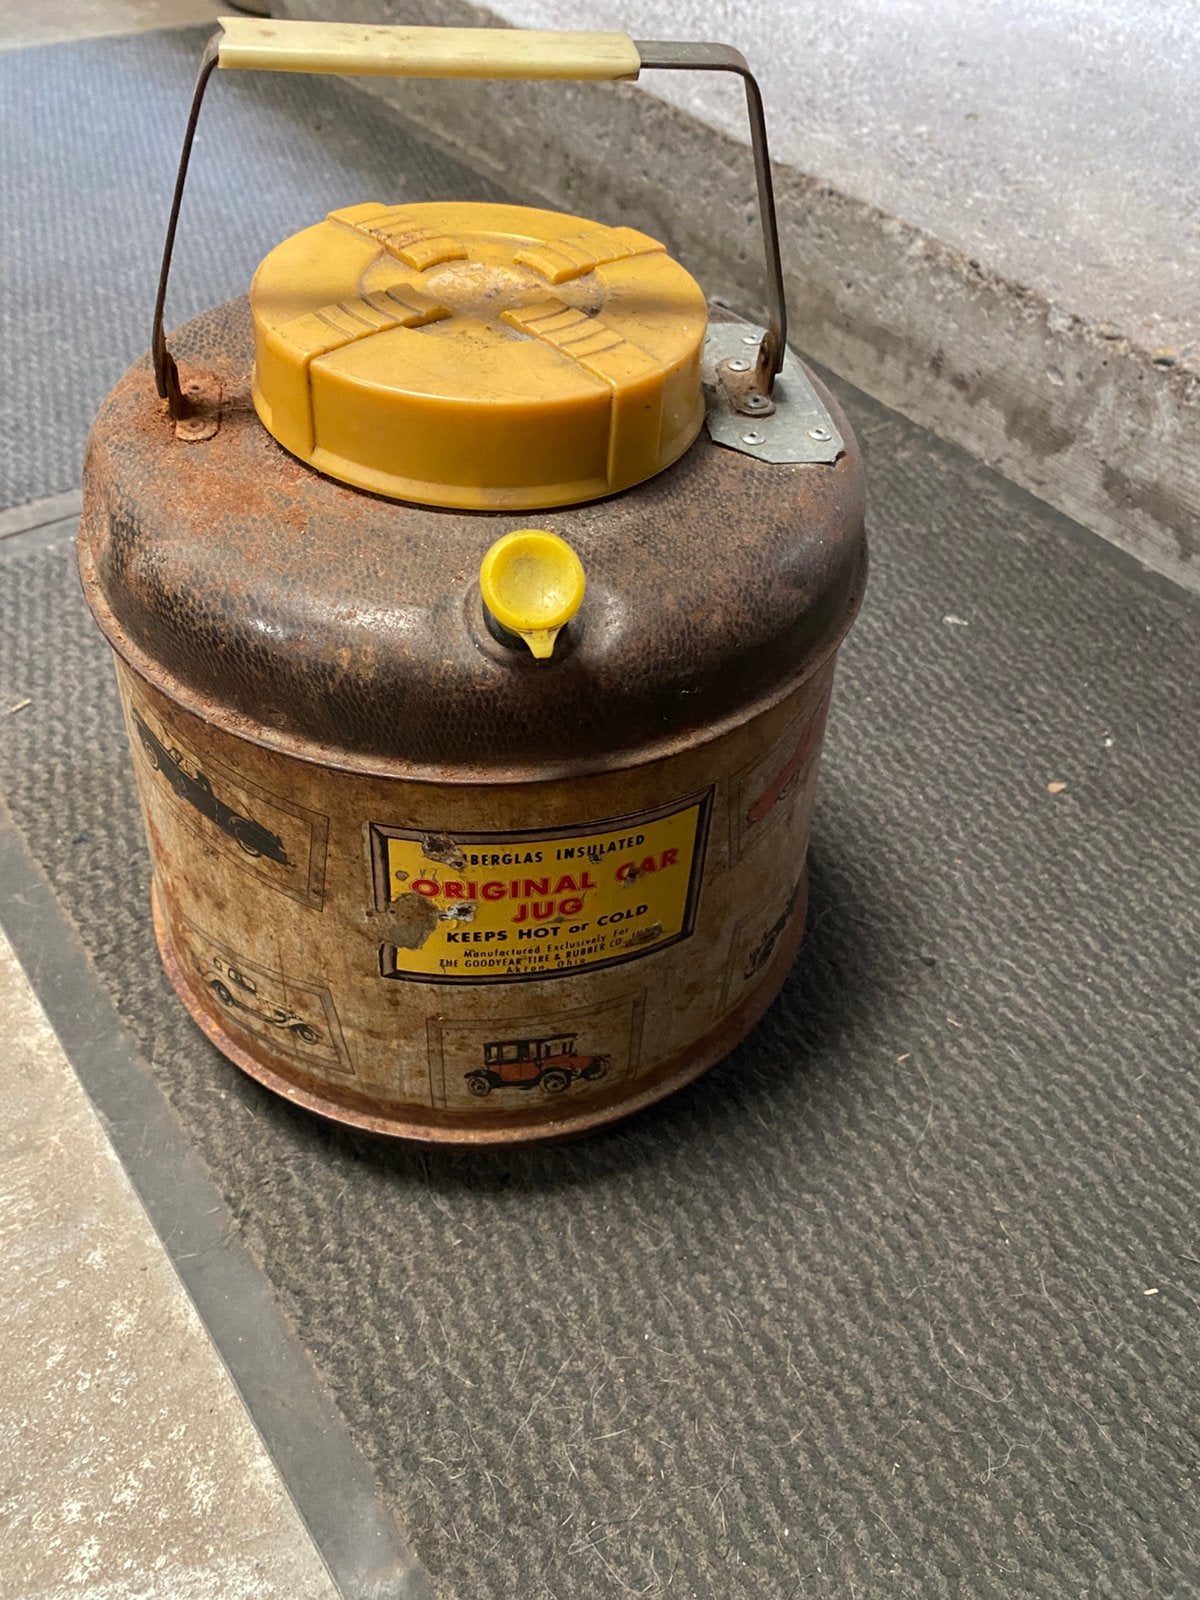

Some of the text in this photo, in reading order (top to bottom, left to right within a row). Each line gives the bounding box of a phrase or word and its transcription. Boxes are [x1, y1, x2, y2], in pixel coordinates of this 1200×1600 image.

[463, 834, 645, 866] BERGLAS INSULATED
[410, 847, 679, 901] ORIGINAL CAR
[447, 904, 649, 943] KEEPS HOT or COLD
[511, 897, 583, 923] JUG
[440, 959, 459, 968] THE
[464, 956, 523, 968] GOODYEAR
[528, 954, 550, 964] TIRE
[554, 953, 561, 961] &
[566, 942, 606, 959] RUBBER
[463, 945, 540, 958] Manufactured
[547, 934, 606, 952] Exclusively
[613, 927, 629, 938] For
[557, 958, 586, 968] Ohio
